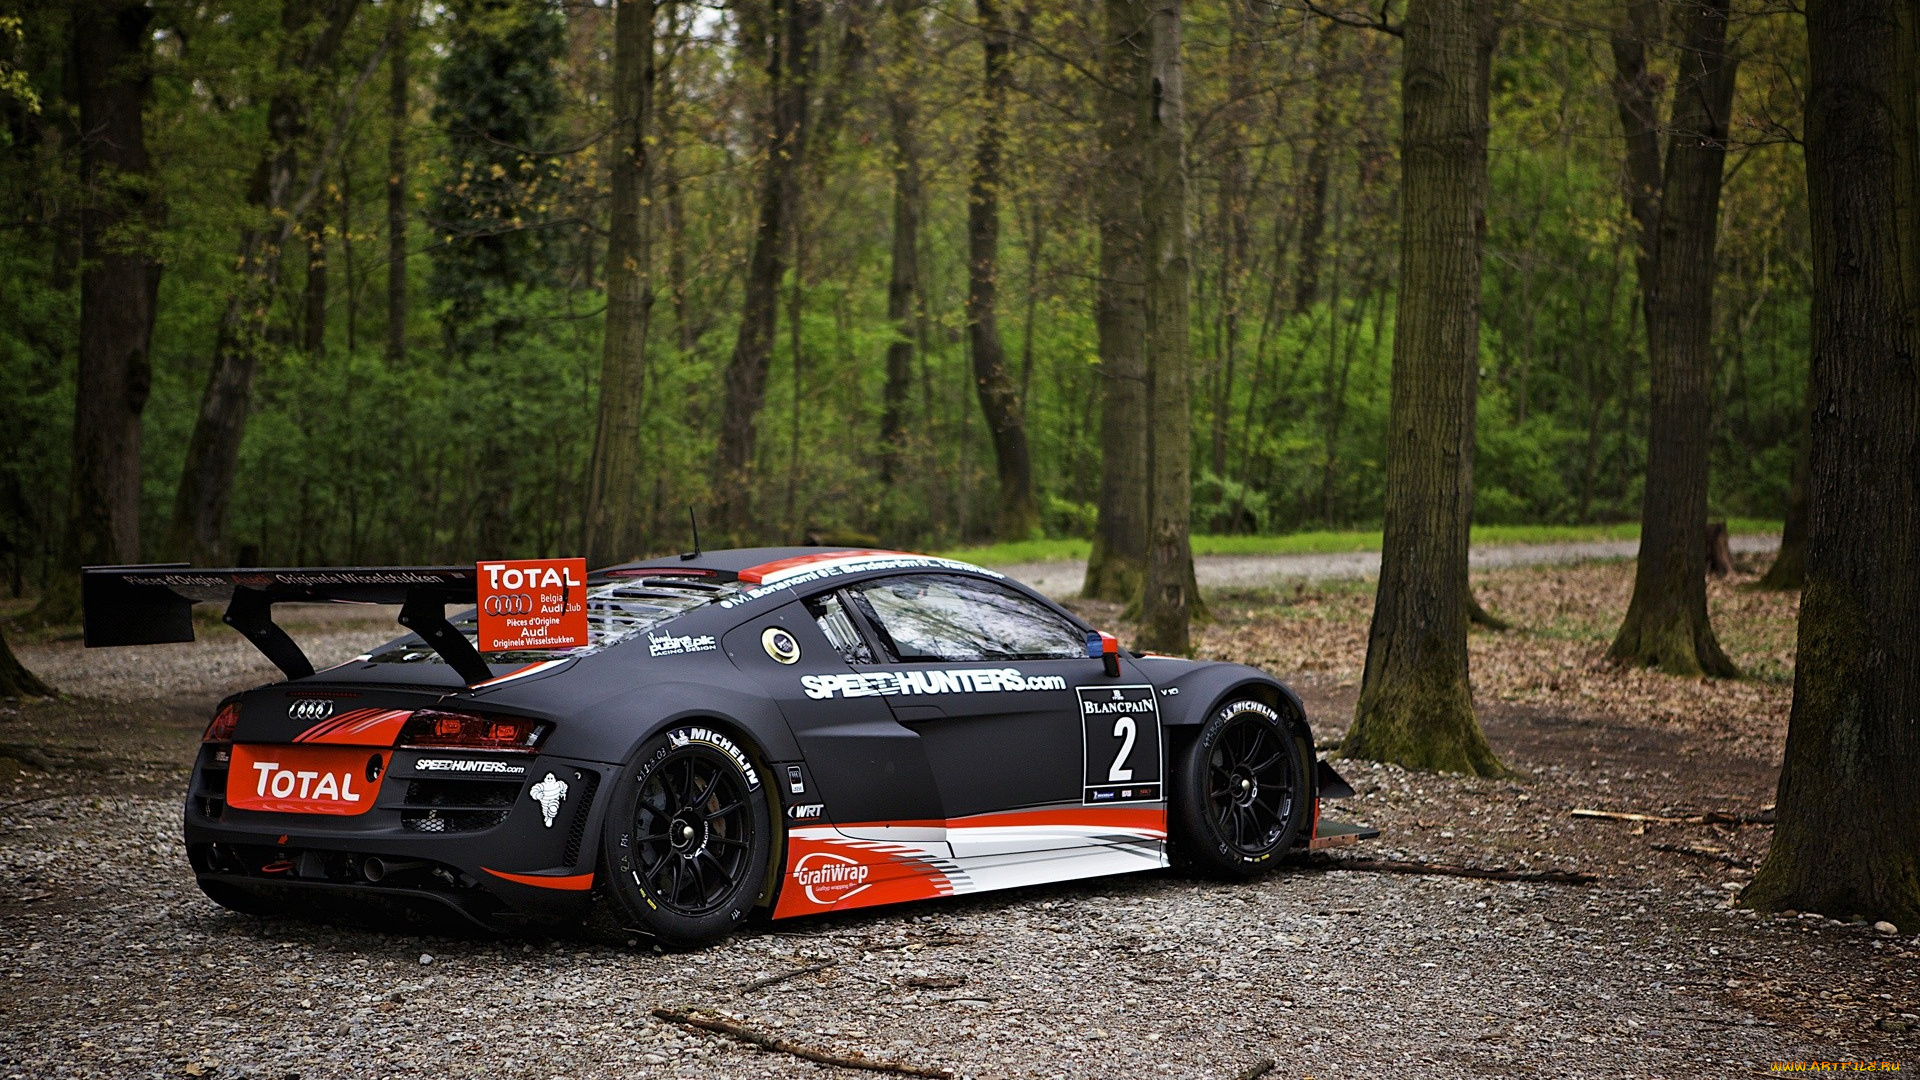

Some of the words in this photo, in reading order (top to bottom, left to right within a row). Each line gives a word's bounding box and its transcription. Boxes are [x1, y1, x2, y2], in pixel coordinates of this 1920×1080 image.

[275, 573, 342, 586] Originele
[337, 572, 444, 584] Wisselstukken
[483, 565, 581, 589] TOTAL
[732, 594, 753, 607] M.
[747, 571, 819, 599] Bonanomi
[828, 564, 843, 577] E.
[541, 604, 564, 613] Audi
[507, 617, 528, 627] Pièces
[529, 617, 560, 628] d'Origine
[521, 626, 548, 638] Audi
[493, 638, 525, 649] Originele
[525, 636, 575, 647] Wisselstukken
[652, 648, 684, 657] RACING
[686, 644, 717, 654] DESIGN
[800, 668, 1067, 700] SPEEDHUNTERS.com
[1084, 699, 1155, 714] BLANCPAIN
[1232, 701, 1278, 722] MICHELIN
[1108, 716, 1137, 782] 2
[690, 728, 760, 786] MICHELIN
[415, 759, 525, 774] SPEEDHUNTERS.com
[253, 762, 360, 801] TOTAL
[796, 804, 825, 818] WRT
[798, 864, 869, 886] GrafiWrap
